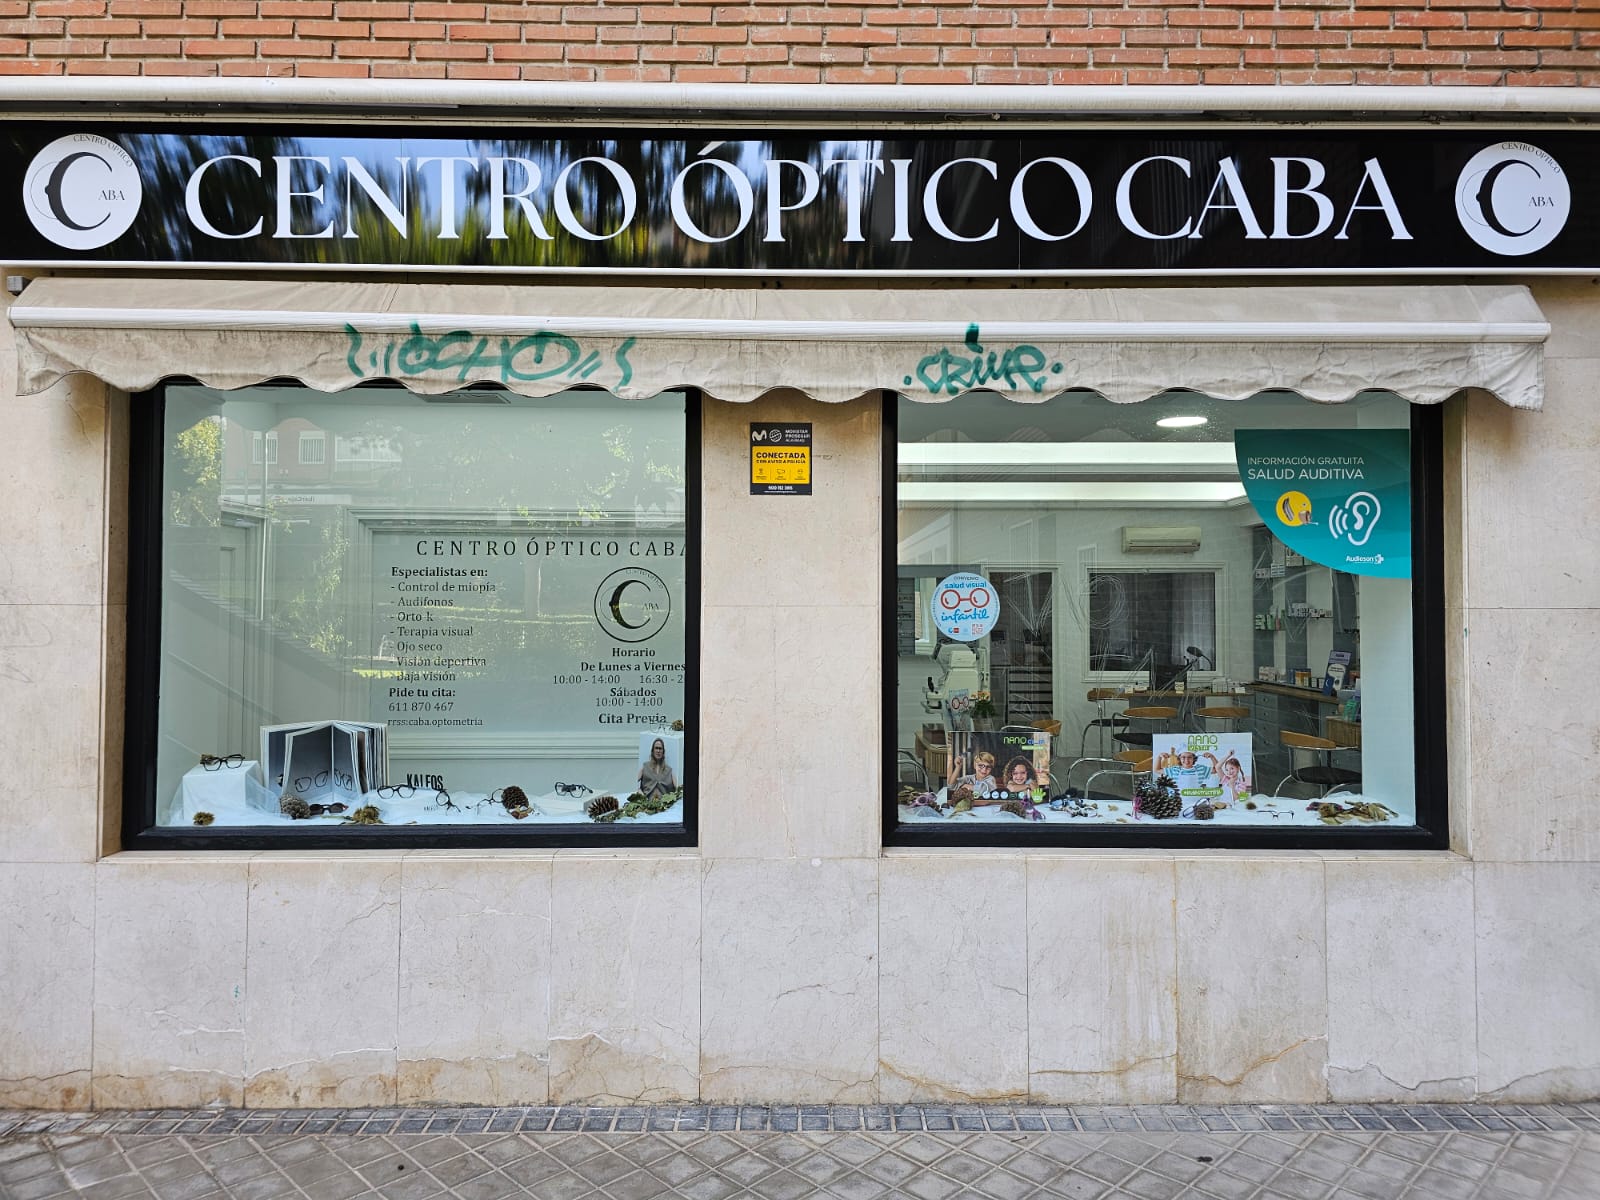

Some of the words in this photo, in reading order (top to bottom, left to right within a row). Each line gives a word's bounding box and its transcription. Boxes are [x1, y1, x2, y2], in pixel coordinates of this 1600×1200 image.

[73, 134, 107, 146] CENTRO
[1501, 142, 1535, 153] CENTRO
[185, 154, 637, 241] CENTRO
[670, 141, 1093, 243] ÓPTICO
[1115, 154, 1414, 241] CABA
[1247, 456, 1315, 465] INFORMACIÓN
[1317, 457, 1365, 465] GRATUITA
[1247, 468, 1295, 480] SALUD
[1298, 468, 1365, 480] AUDITIVA
[416, 540, 518, 556] CENTRO
[526, 536, 620, 556] ÓPTICO
[391, 566, 467, 579] Especialistas
[470, 569, 488, 577] en:
[398, 582, 439, 592] Control
[441, 582, 455, 592] de
[458, 581, 496, 594] miopía
[941, 607, 990, 623] infantil
[397, 627, 439, 638] Terapia
[441, 626, 474, 636] visual
[397, 641, 416, 653] Ojo
[418, 643, 443, 652] seco
[612, 647, 656, 657] Horario
[397, 656, 431, 667] Visión
[433, 656, 487, 669] deportiva
[580, 661, 596, 671] De
[598, 661, 632, 672] Lunes
[644, 661, 685, 672] Viernes
[396, 671, 420, 683] Baja
[423, 671, 456, 681] visión
[553, 675, 582, 685] 10:00
[591, 675, 621, 684] 14:00
[640, 675, 668, 684] 16:30
[389, 687, 414, 697] Pide
[417, 688, 429, 697] tu
[431, 687, 456, 697] cita:
[610, 687, 657, 697] Sábados
[388, 702, 408, 712] 611
[411, 702, 432, 712] 870
[433, 702, 454, 712] 467
[595, 698, 625, 707] 10:00
[634, 697, 663, 707] 14:00
[598, 713, 623, 724] Cita
[626, 713, 667, 724] Previa
